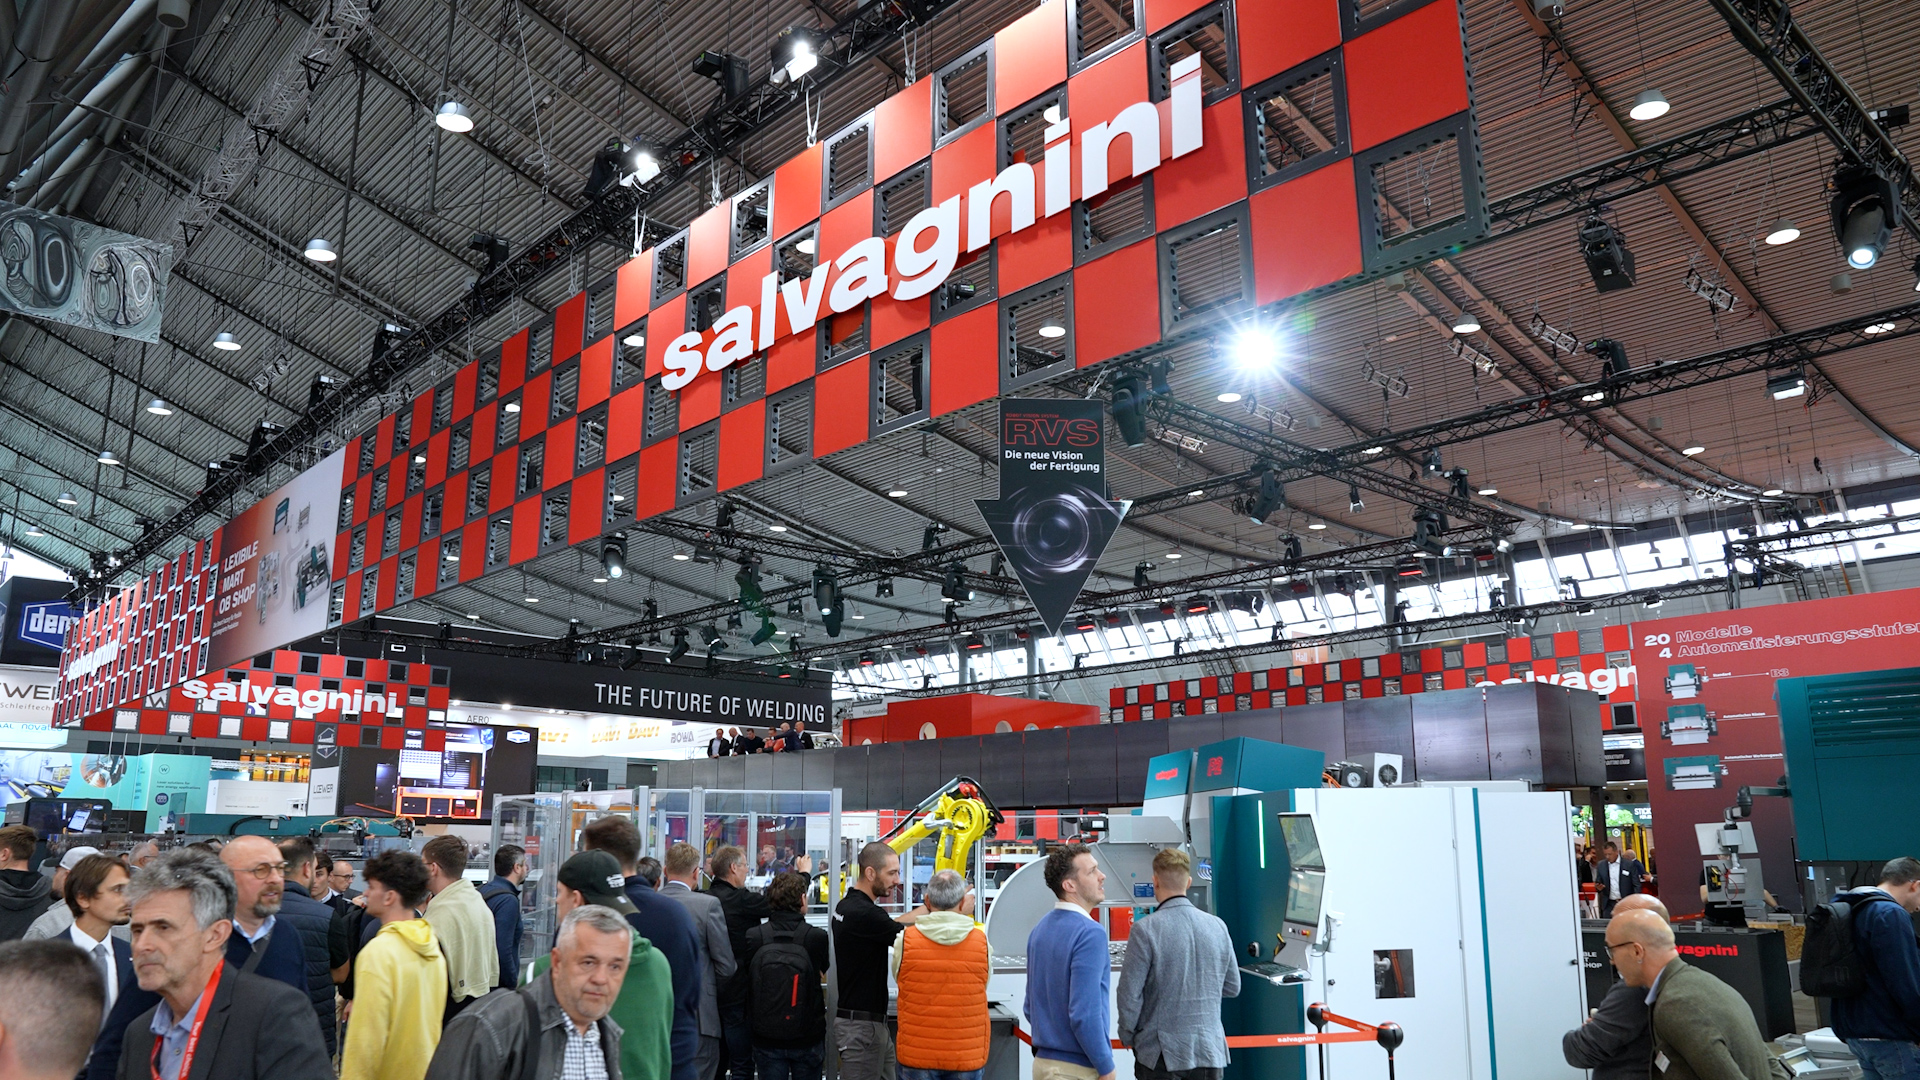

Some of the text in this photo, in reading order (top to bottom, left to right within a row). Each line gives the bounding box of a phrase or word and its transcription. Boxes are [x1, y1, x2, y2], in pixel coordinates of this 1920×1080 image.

[661, 51, 1204, 391] salvagnini
[1005, 418, 1100, 447] RVS
[1004, 449, 1084, 460] Die neue Vision
[1029, 461, 1100, 473] der Fertigung
[232, 583, 257, 608] SHOP
[1644, 624, 1753, 647] 20 Modelle
[1658, 647, 1673, 659] 4
[1770, 667, 1790, 678] B3
[181, 678, 398, 714] salvagnini
[594, 682, 825, 724] THE FUTURE OF WELDING
[466, 715, 490, 725] AERO
[627, 722, 660, 740] DAVI
[670, 730, 695, 744] BOWA
[1277, 1035, 1317, 1043] salvagnini
